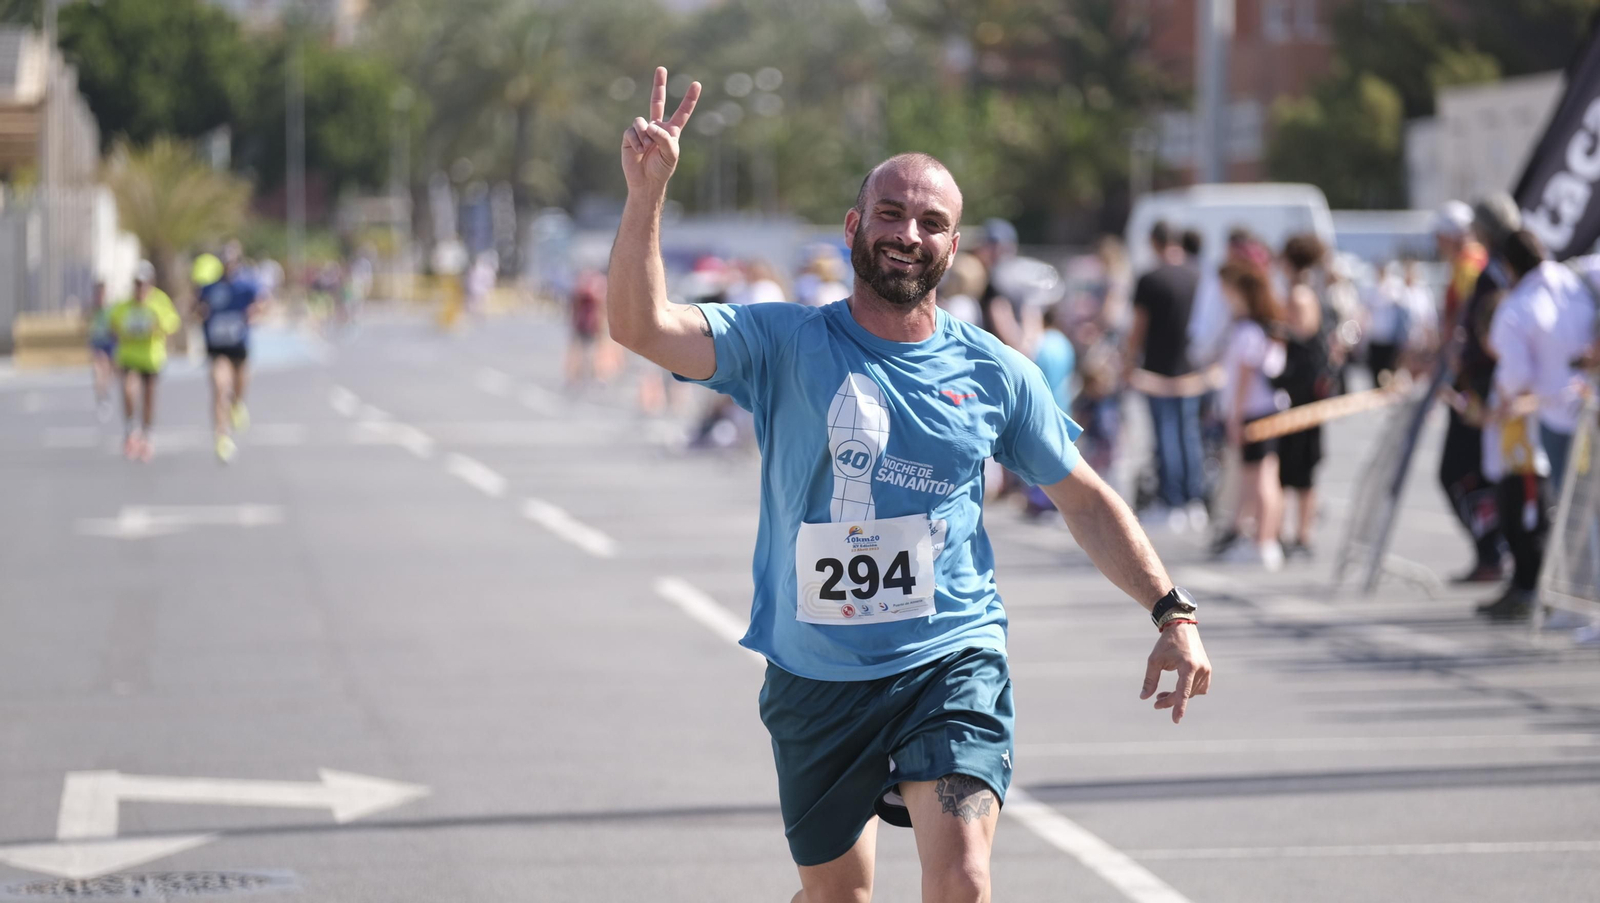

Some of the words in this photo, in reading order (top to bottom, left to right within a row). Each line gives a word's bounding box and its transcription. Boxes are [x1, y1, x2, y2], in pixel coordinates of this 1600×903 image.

[837, 449, 869, 470] 40
[881, 457, 918, 475] NOCHE
[916, 467, 934, 479] DE
[875, 467, 908, 487] SAN
[846, 535, 880, 543] 10km20
[815, 550, 916, 600] 294
